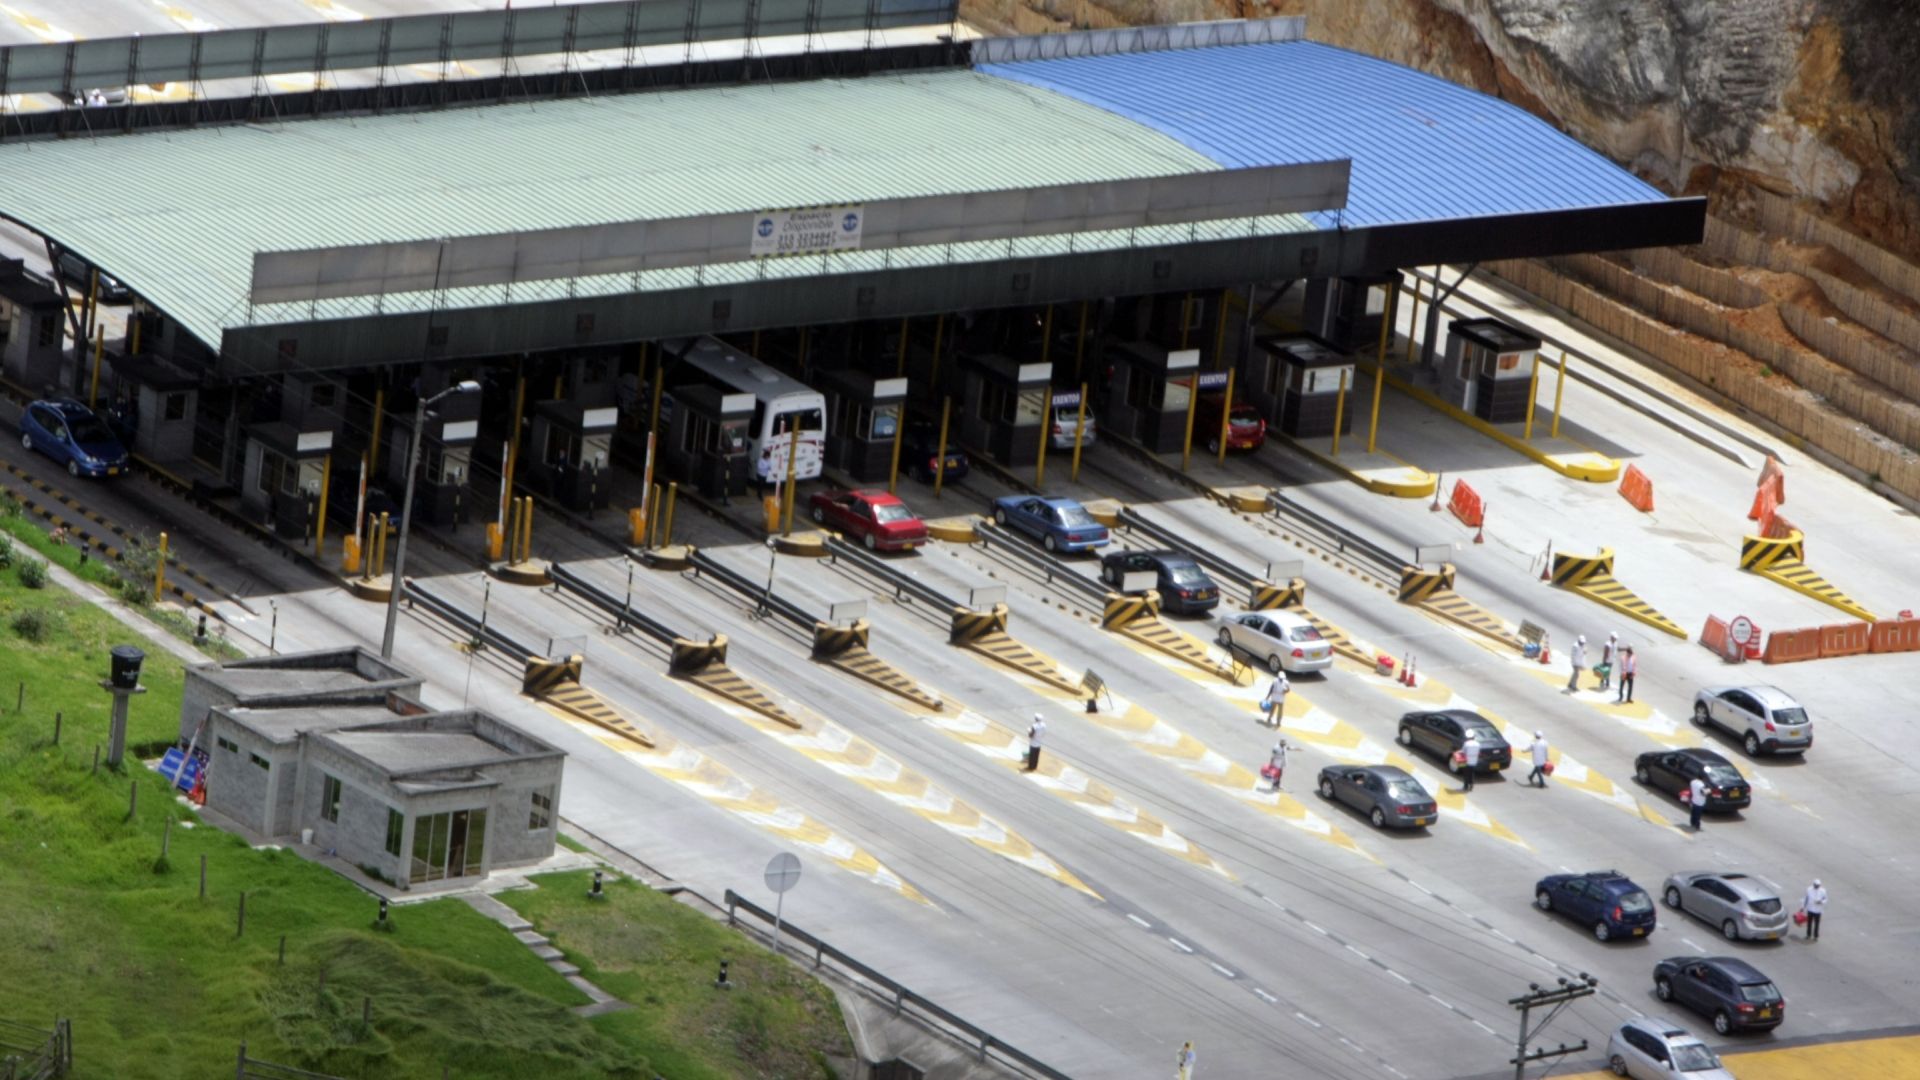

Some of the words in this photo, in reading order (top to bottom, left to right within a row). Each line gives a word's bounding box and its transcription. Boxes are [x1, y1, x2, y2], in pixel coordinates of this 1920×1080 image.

[790, 212, 832, 221] Espacio
[783, 219, 834, 232] Disponible
[1199, 373, 1227, 384] EXENTOS
[1052, 393, 1080, 405] EXENTOS
